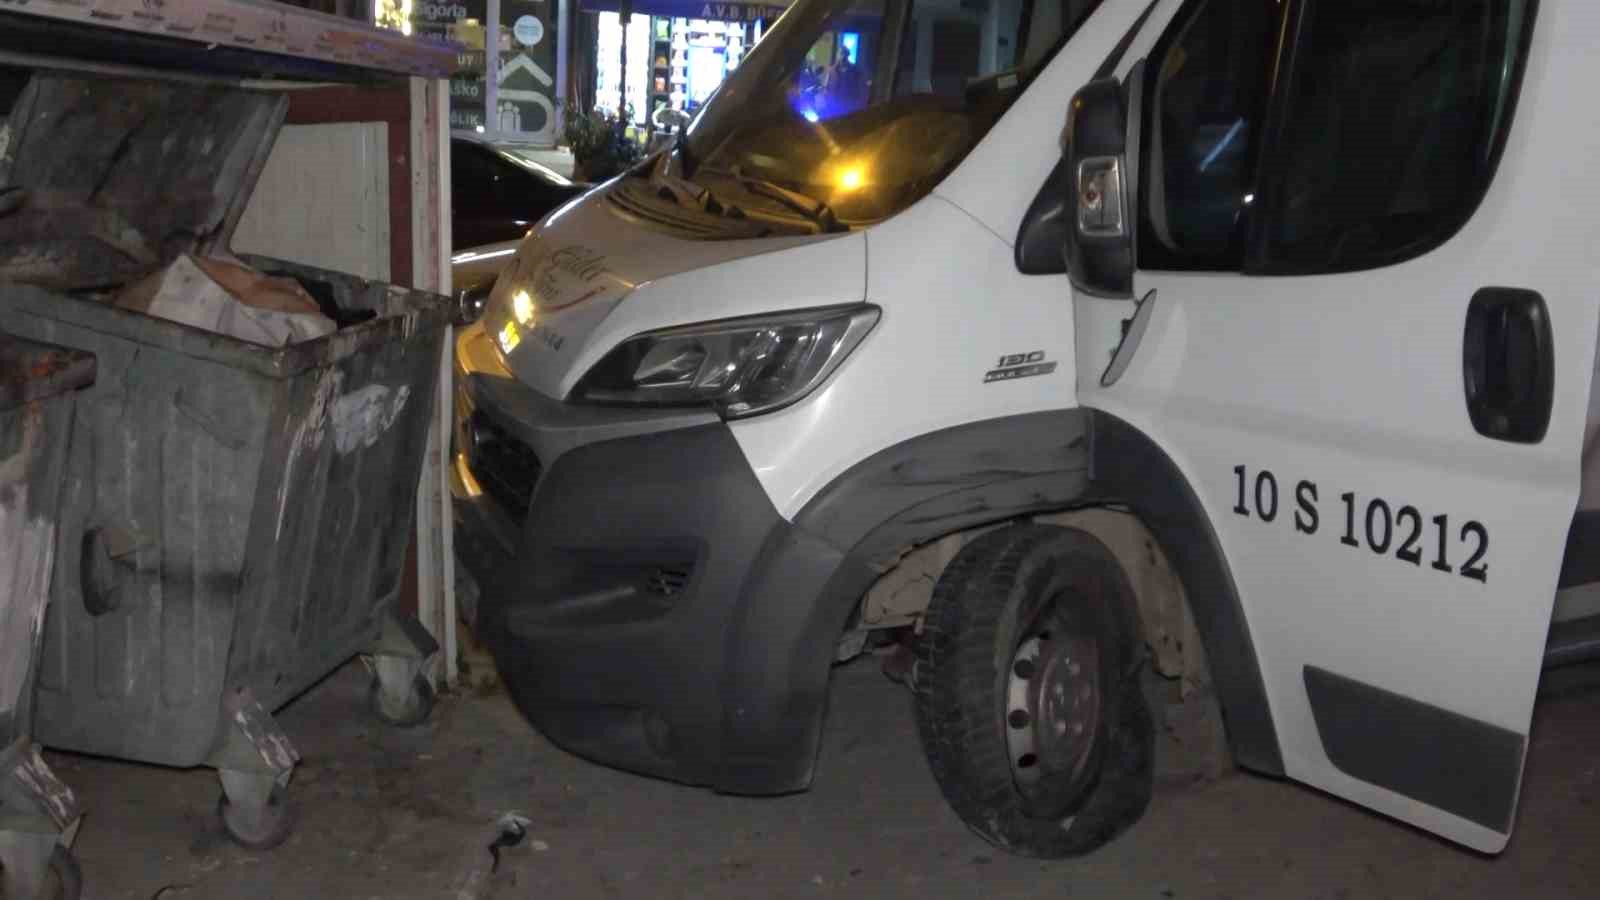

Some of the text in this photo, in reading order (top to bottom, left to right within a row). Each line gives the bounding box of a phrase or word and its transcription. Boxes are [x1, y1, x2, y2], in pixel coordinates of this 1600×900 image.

[1233, 464, 1489, 583] 10 S 10212
